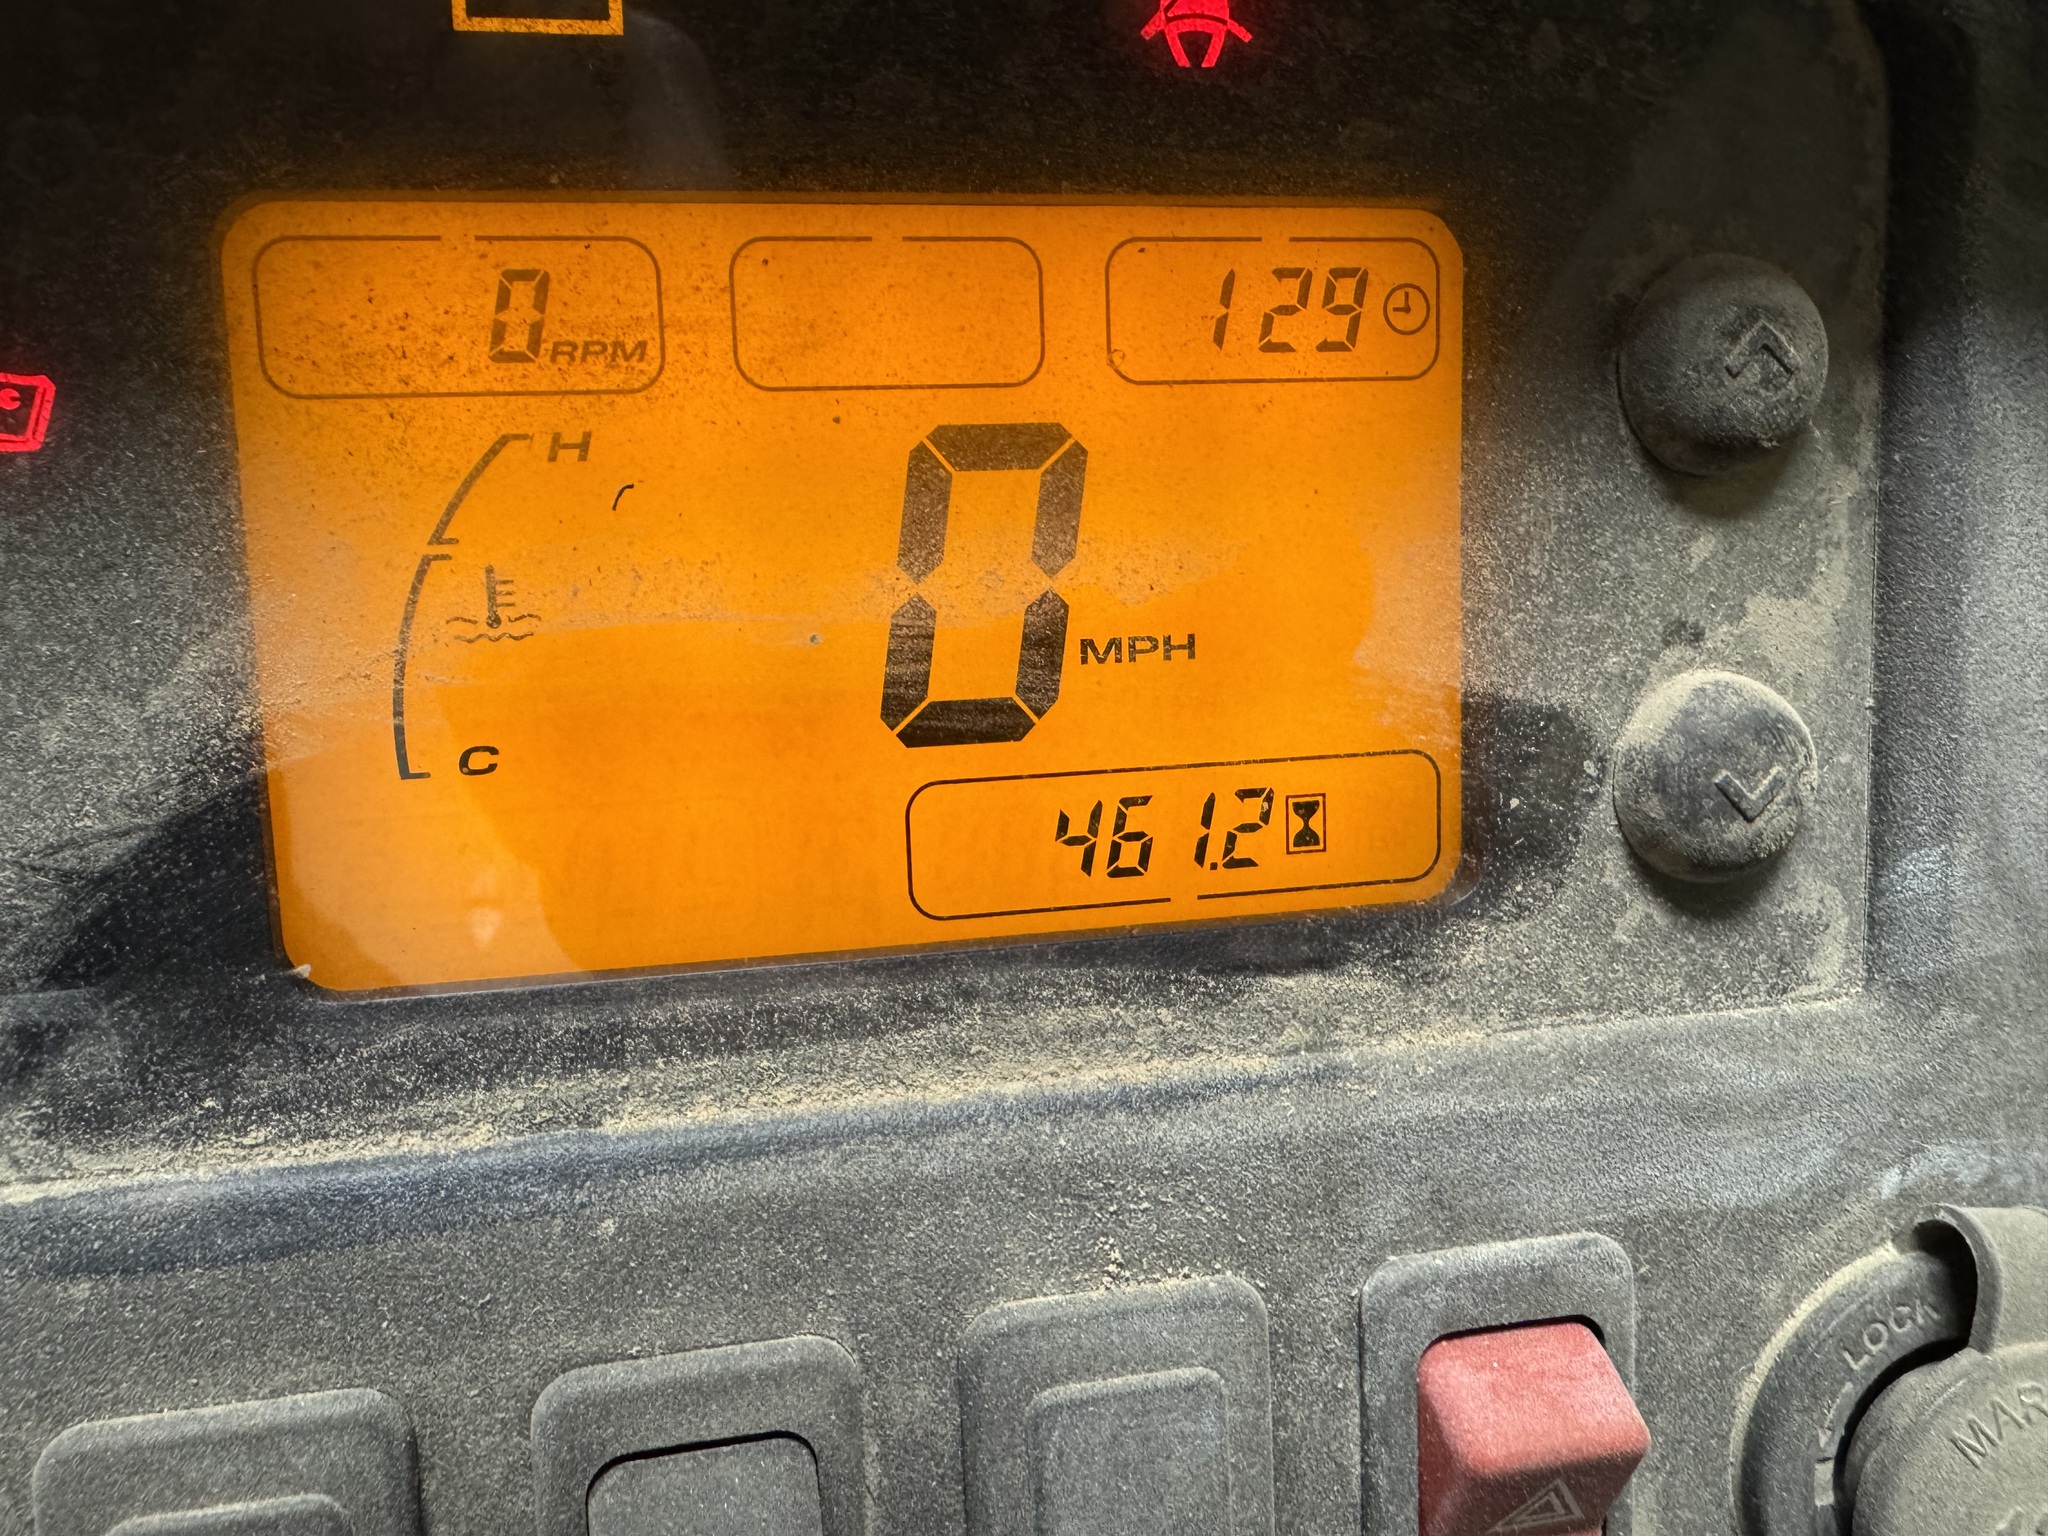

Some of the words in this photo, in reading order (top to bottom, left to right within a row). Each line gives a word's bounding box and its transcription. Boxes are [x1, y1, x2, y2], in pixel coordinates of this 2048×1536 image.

[489, 268, 550, 363] 0
[549, 340, 648, 364] RPM
[1213, 267, 1369, 352] 129
[547, 431, 592, 462] H
[880, 422, 1088, 748] 0
[1080, 633, 1197, 665] MPH
[458, 745, 499, 777] C
[1055, 787, 1274, 878] 461.2
